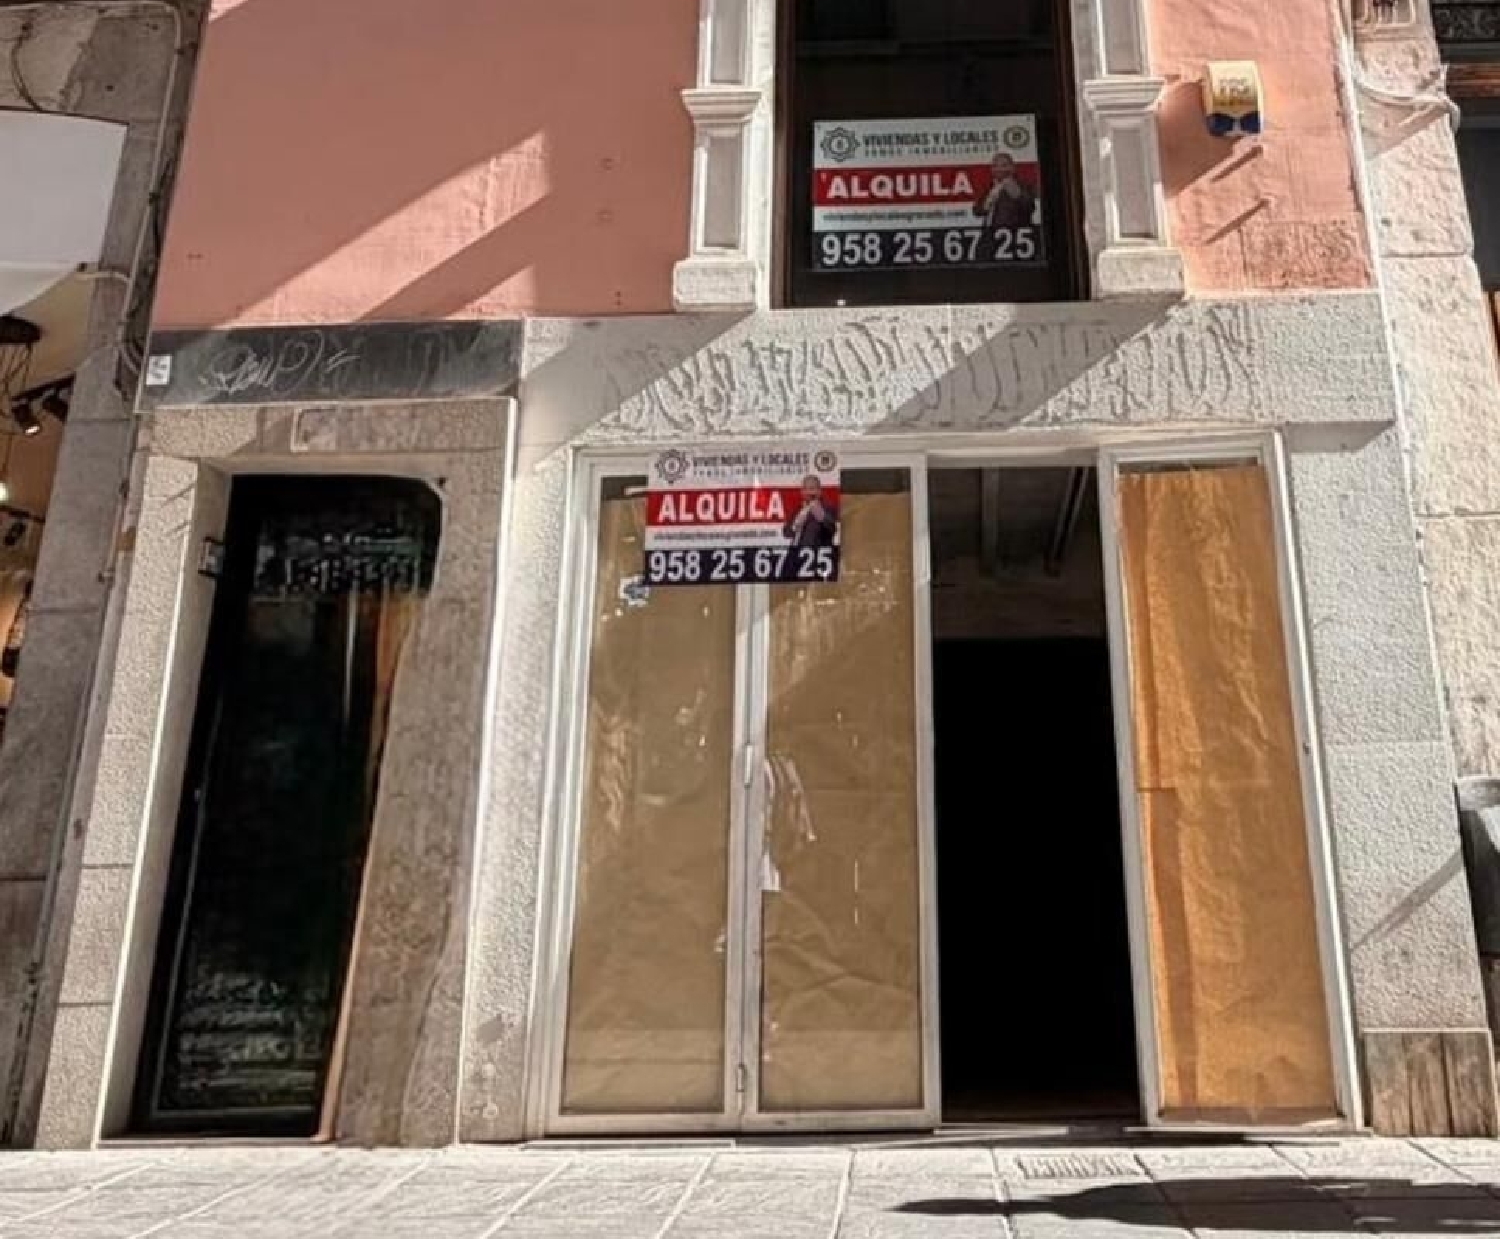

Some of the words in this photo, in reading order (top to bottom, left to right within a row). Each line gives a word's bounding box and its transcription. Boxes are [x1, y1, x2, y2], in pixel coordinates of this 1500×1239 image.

[943, 130, 999, 144] LOCALES
[826, 171, 974, 199] ALQUILA
[822, 232, 882, 265] 958
[893, 232, 934, 263] 25
[944, 230, 982, 261] 67
[994, 228, 1035, 259] 25
[658, 491, 785, 522] ALQUILA
[649, 550, 701, 582] 958
[710, 549, 745, 580] 25
[754, 548, 788, 578] 67
[797, 547, 833, 577] 25
